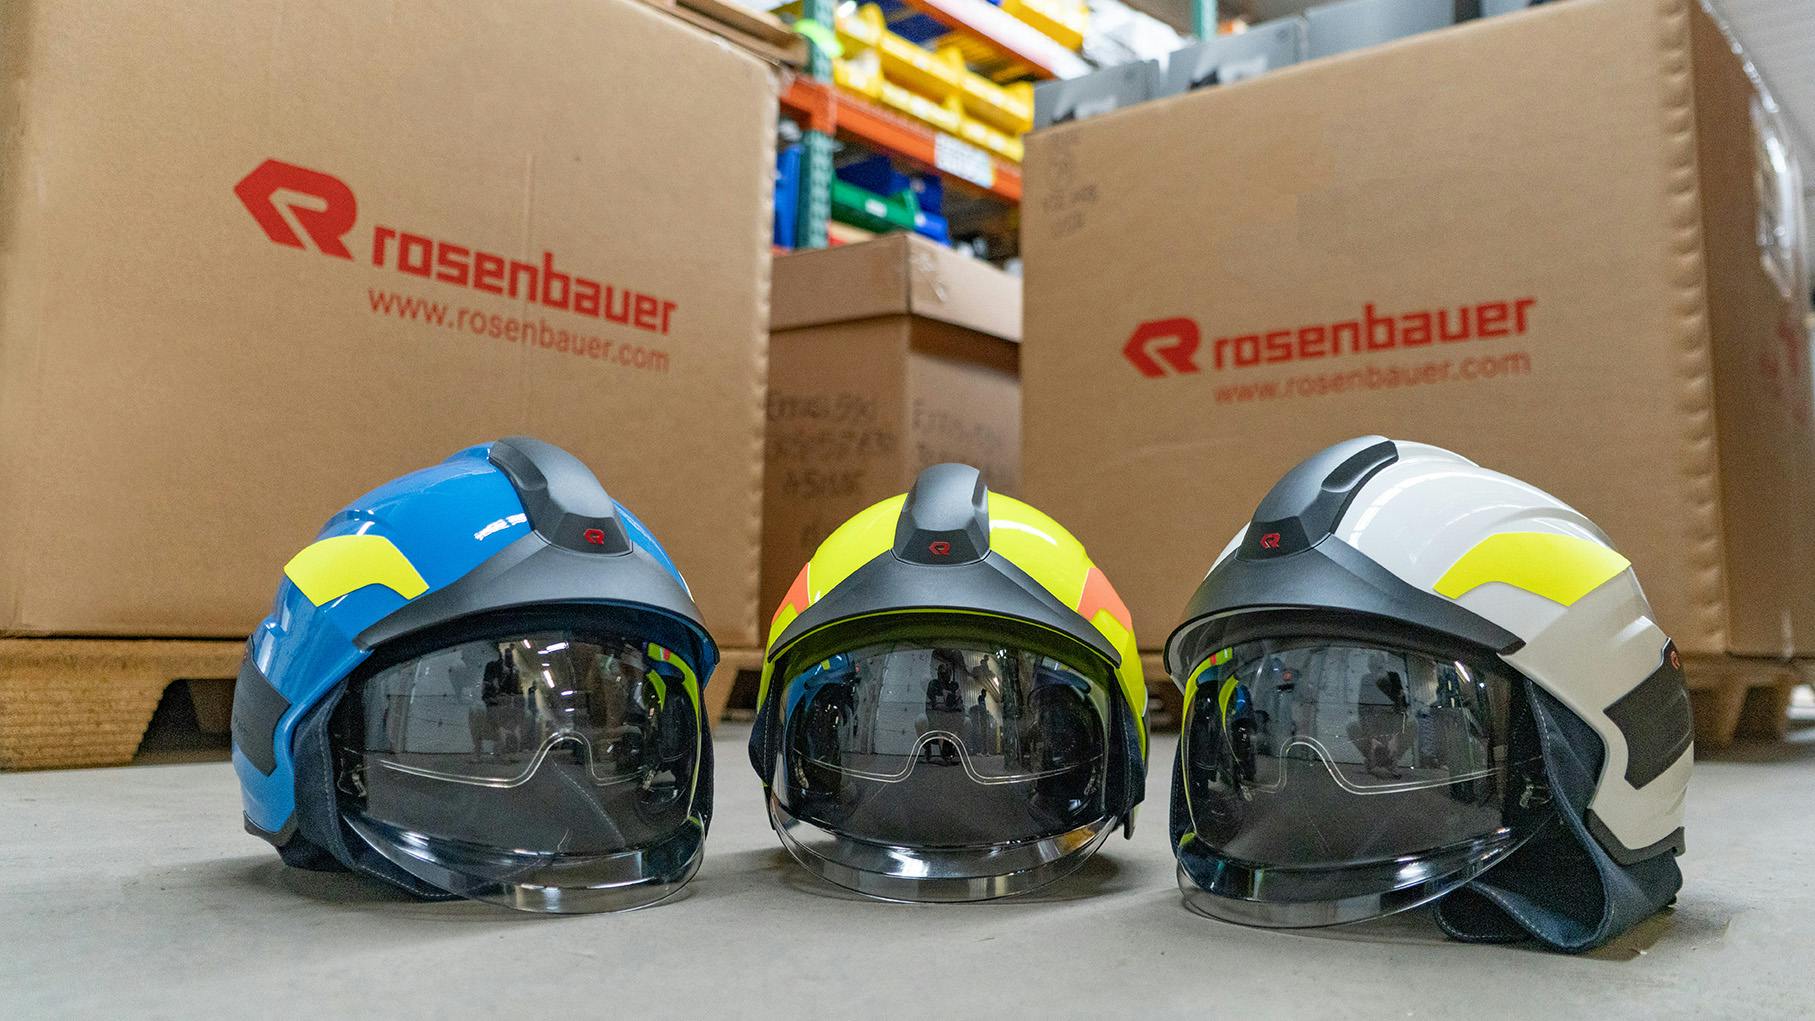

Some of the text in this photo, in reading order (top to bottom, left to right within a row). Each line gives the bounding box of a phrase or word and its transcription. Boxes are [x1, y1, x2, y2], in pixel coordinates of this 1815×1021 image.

[372, 226, 677, 335] rosenbauer
[368, 288, 670, 373] www.rosenbauer.com
[1213, 298, 1535, 370] rosenbauer
[1215, 351, 1531, 404] www.rosenbauer.com
